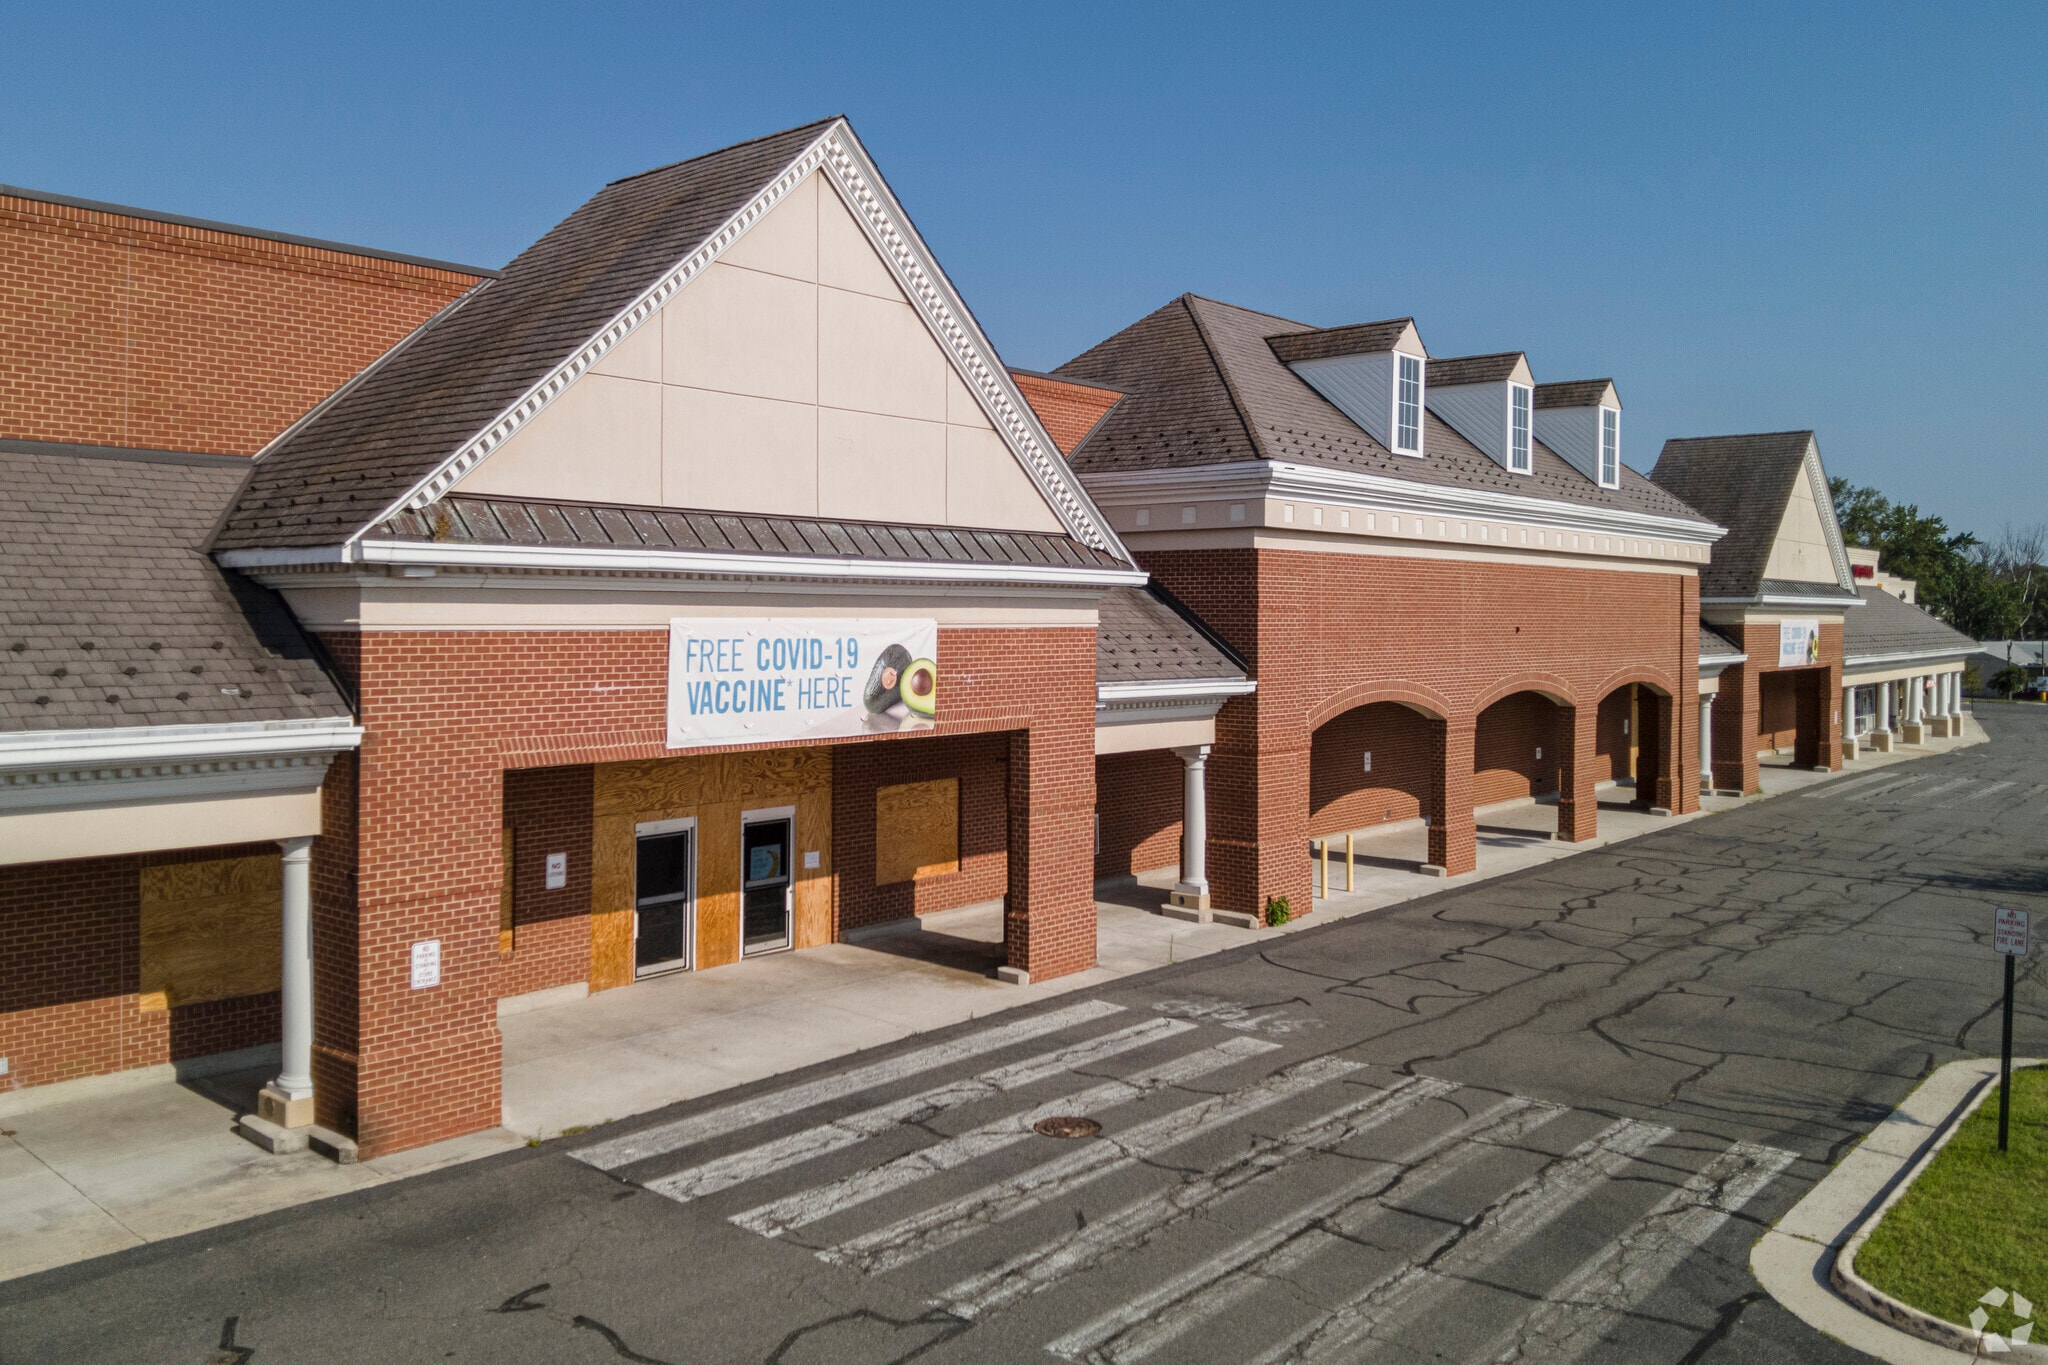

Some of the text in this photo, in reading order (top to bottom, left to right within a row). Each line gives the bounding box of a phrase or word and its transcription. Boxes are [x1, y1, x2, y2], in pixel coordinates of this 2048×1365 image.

[686, 637, 859, 673] FREE COVID-19
[798, 676, 853, 710] HERE
[2007, 911, 2017, 920] NO
[1998, 919, 2025, 928] PARKING
[1997, 929, 2026, 939] STANDING
[1996, 936, 2025, 947] FIRE LANE
